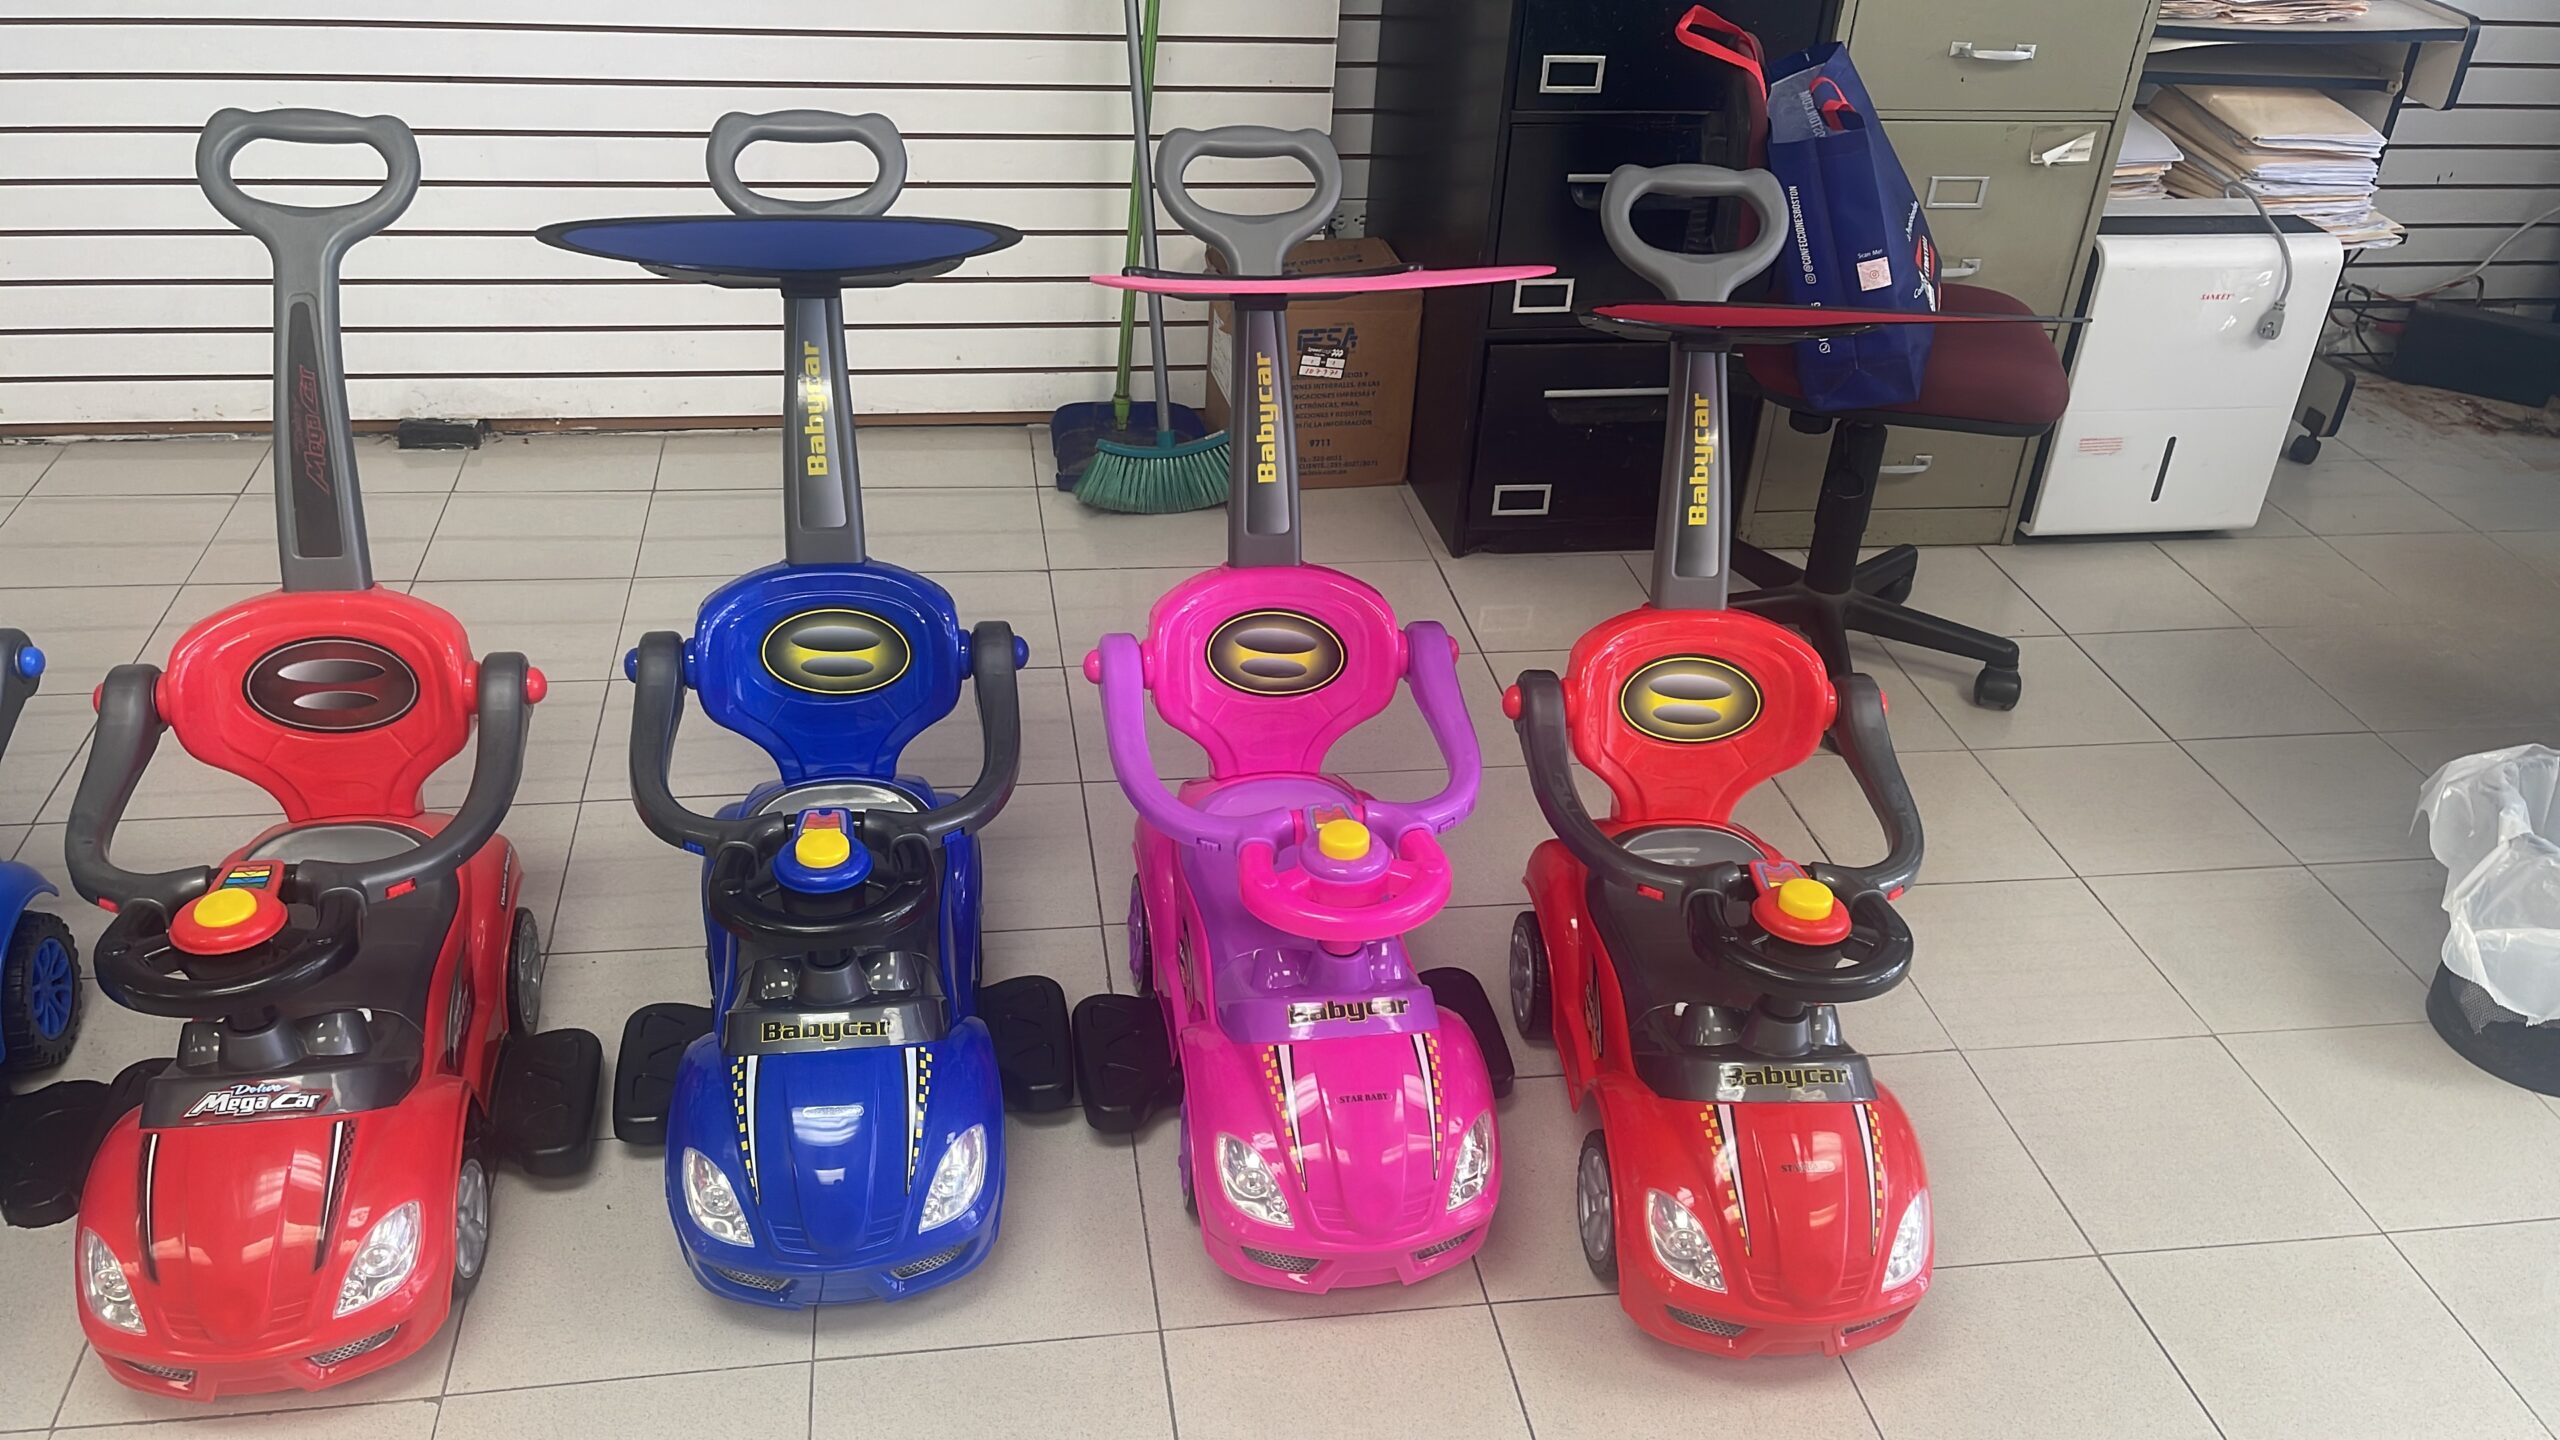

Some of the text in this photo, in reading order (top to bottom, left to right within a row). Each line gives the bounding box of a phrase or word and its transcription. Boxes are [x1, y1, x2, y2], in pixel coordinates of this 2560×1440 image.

[1789, 185, 1814, 273] @CONFECCIONESBOSTON
[2200, 293, 2231, 301] SANKEY
[803, 340, 829, 476] Babycar
[1256, 351, 1279, 483] Babycar
[1688, 393, 1714, 526] Babycar
[761, 1020, 891, 1043] Babycar
[184, 1091, 321, 1118] Mega Car
[1339, 1092, 1389, 1104] STAR BABY
